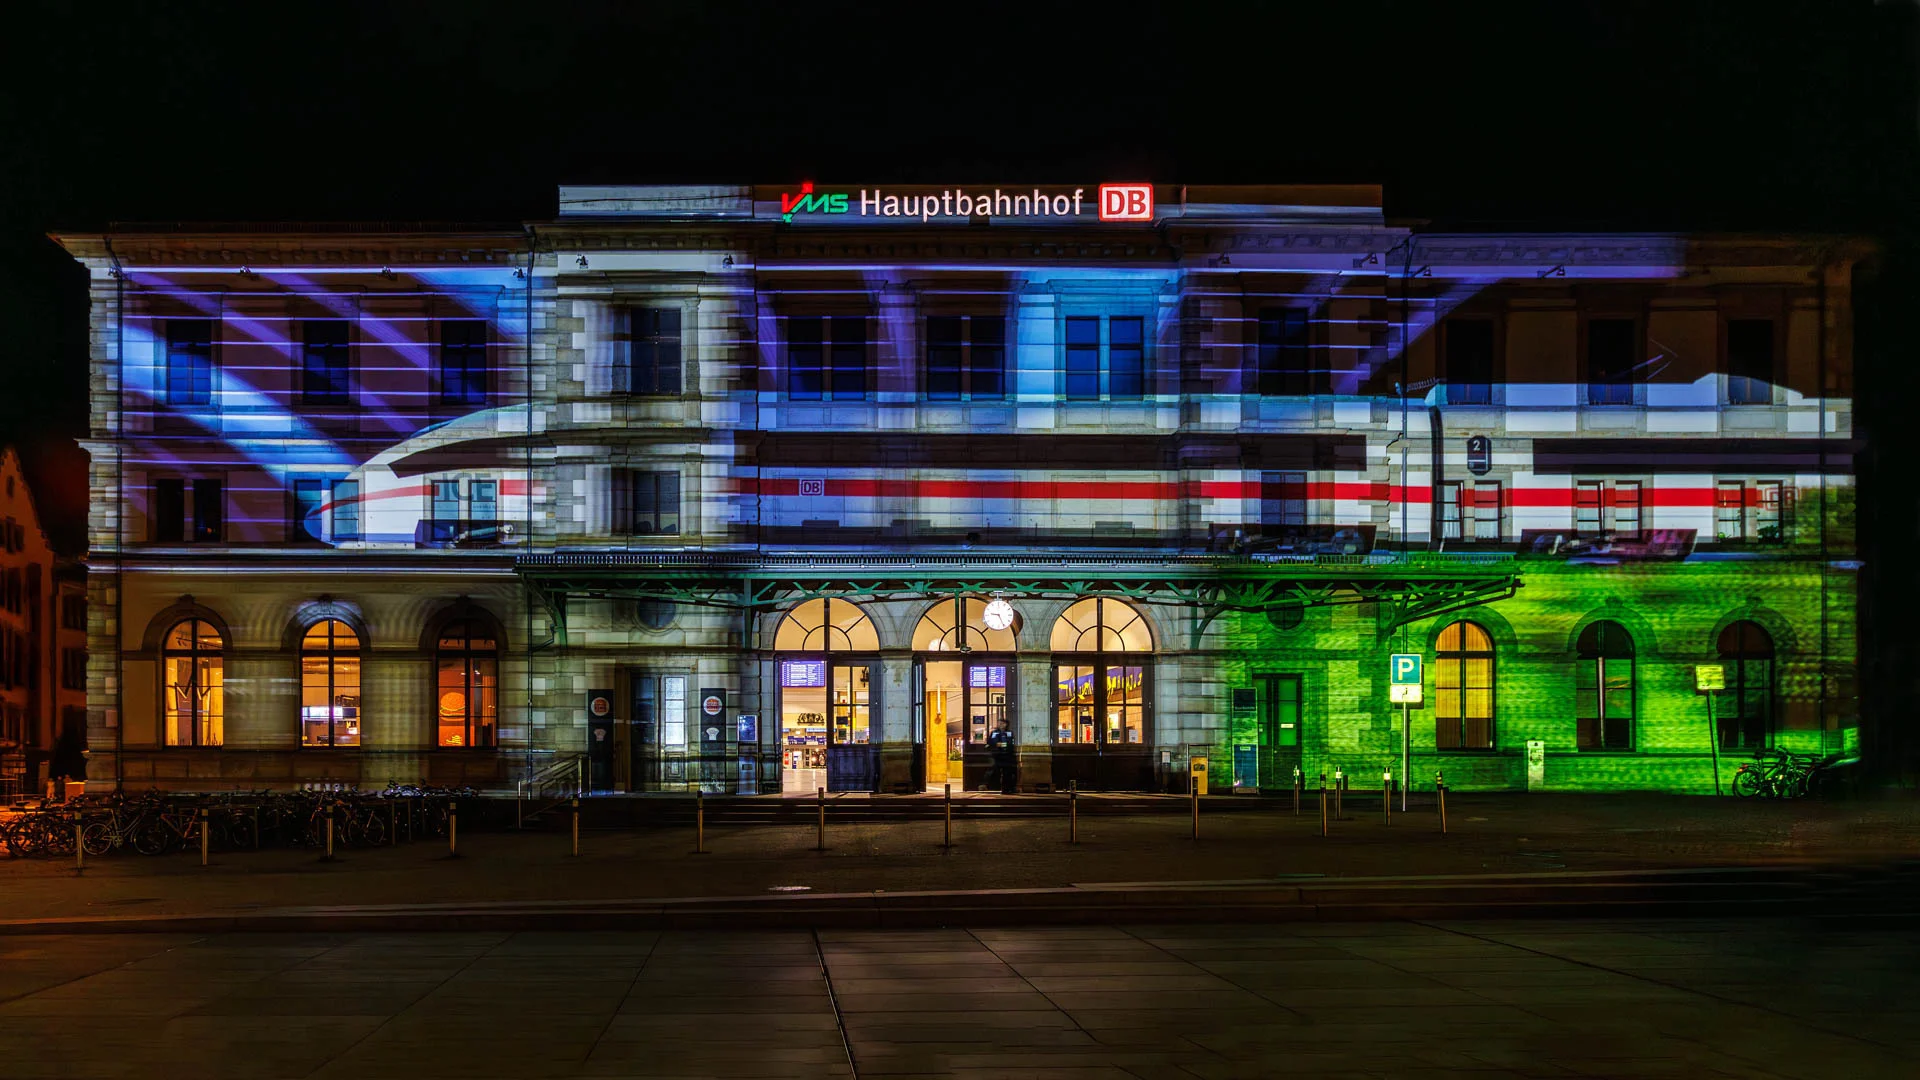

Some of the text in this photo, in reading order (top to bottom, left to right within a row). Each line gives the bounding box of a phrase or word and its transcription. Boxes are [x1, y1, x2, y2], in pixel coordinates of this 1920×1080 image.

[861, 189, 1083, 223] Hauptbahnhof
[1104, 189, 1148, 217] DB
[1473, 440, 1481, 451] 2
[443, 473, 493, 500] ICE
[803, 481, 820, 493] DB
[1398, 658, 1415, 681] P
